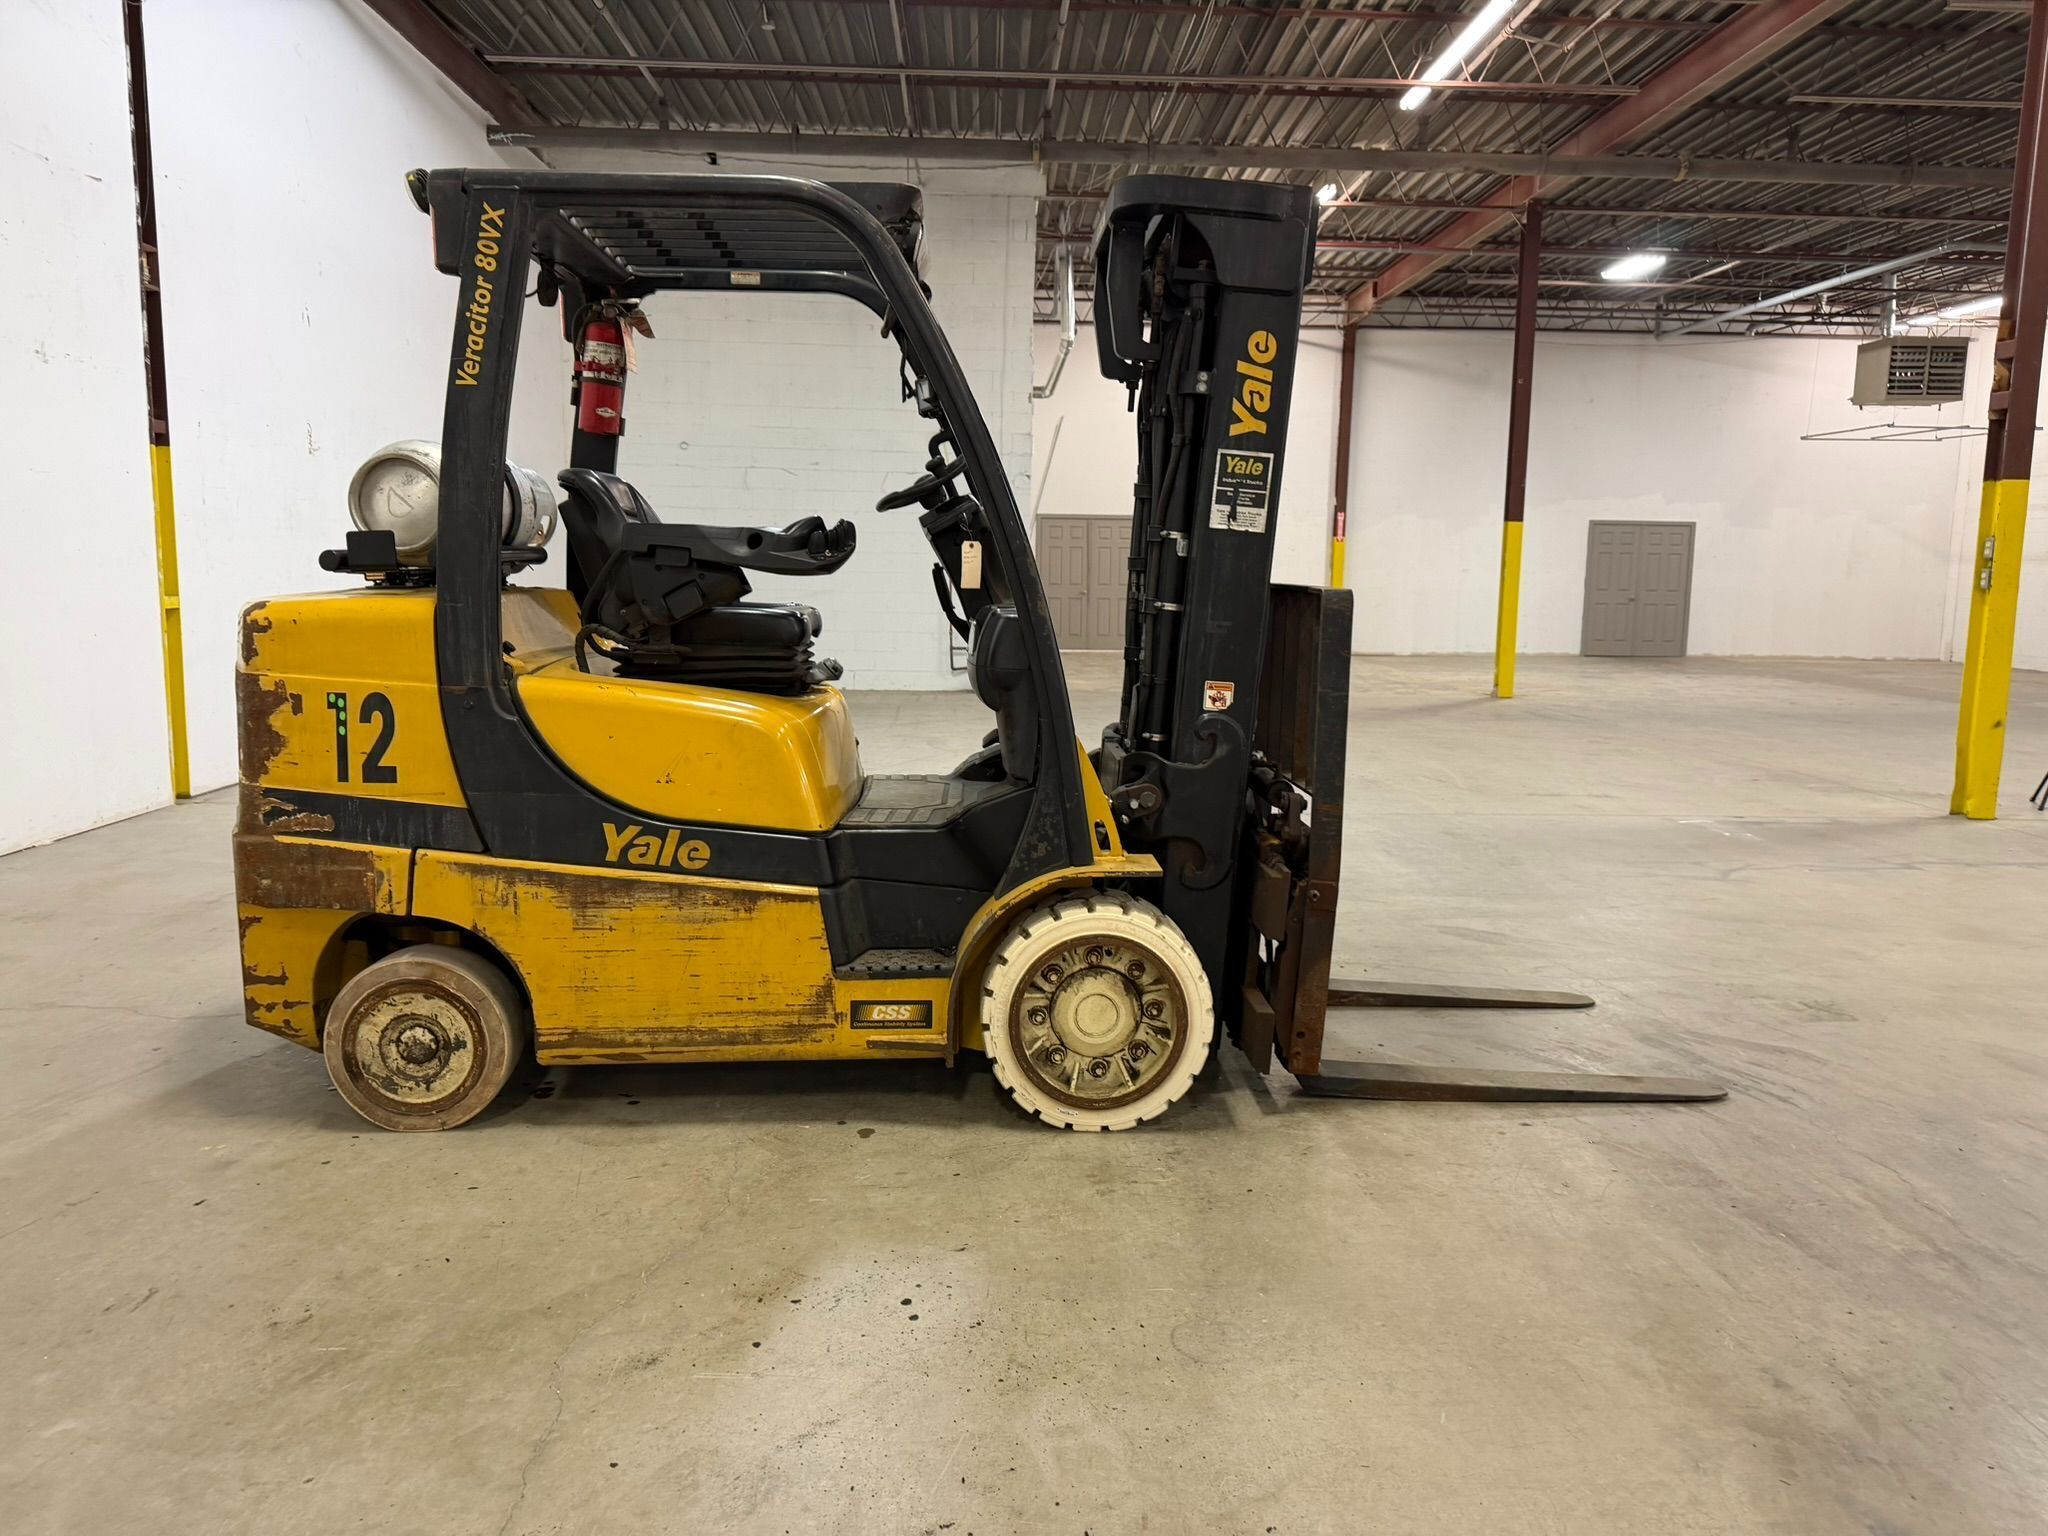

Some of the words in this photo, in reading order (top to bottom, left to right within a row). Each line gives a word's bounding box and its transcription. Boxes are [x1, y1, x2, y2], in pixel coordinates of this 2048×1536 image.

[455, 275, 493, 386] Veracitor
[474, 201, 506, 272] 80VX
[1229, 330, 1278, 437] Yale
[1226, 456, 1264, 476] Yale
[326, 691, 398, 784] 12
[602, 822, 711, 870] Yale
[872, 1005, 911, 1020] CSS
